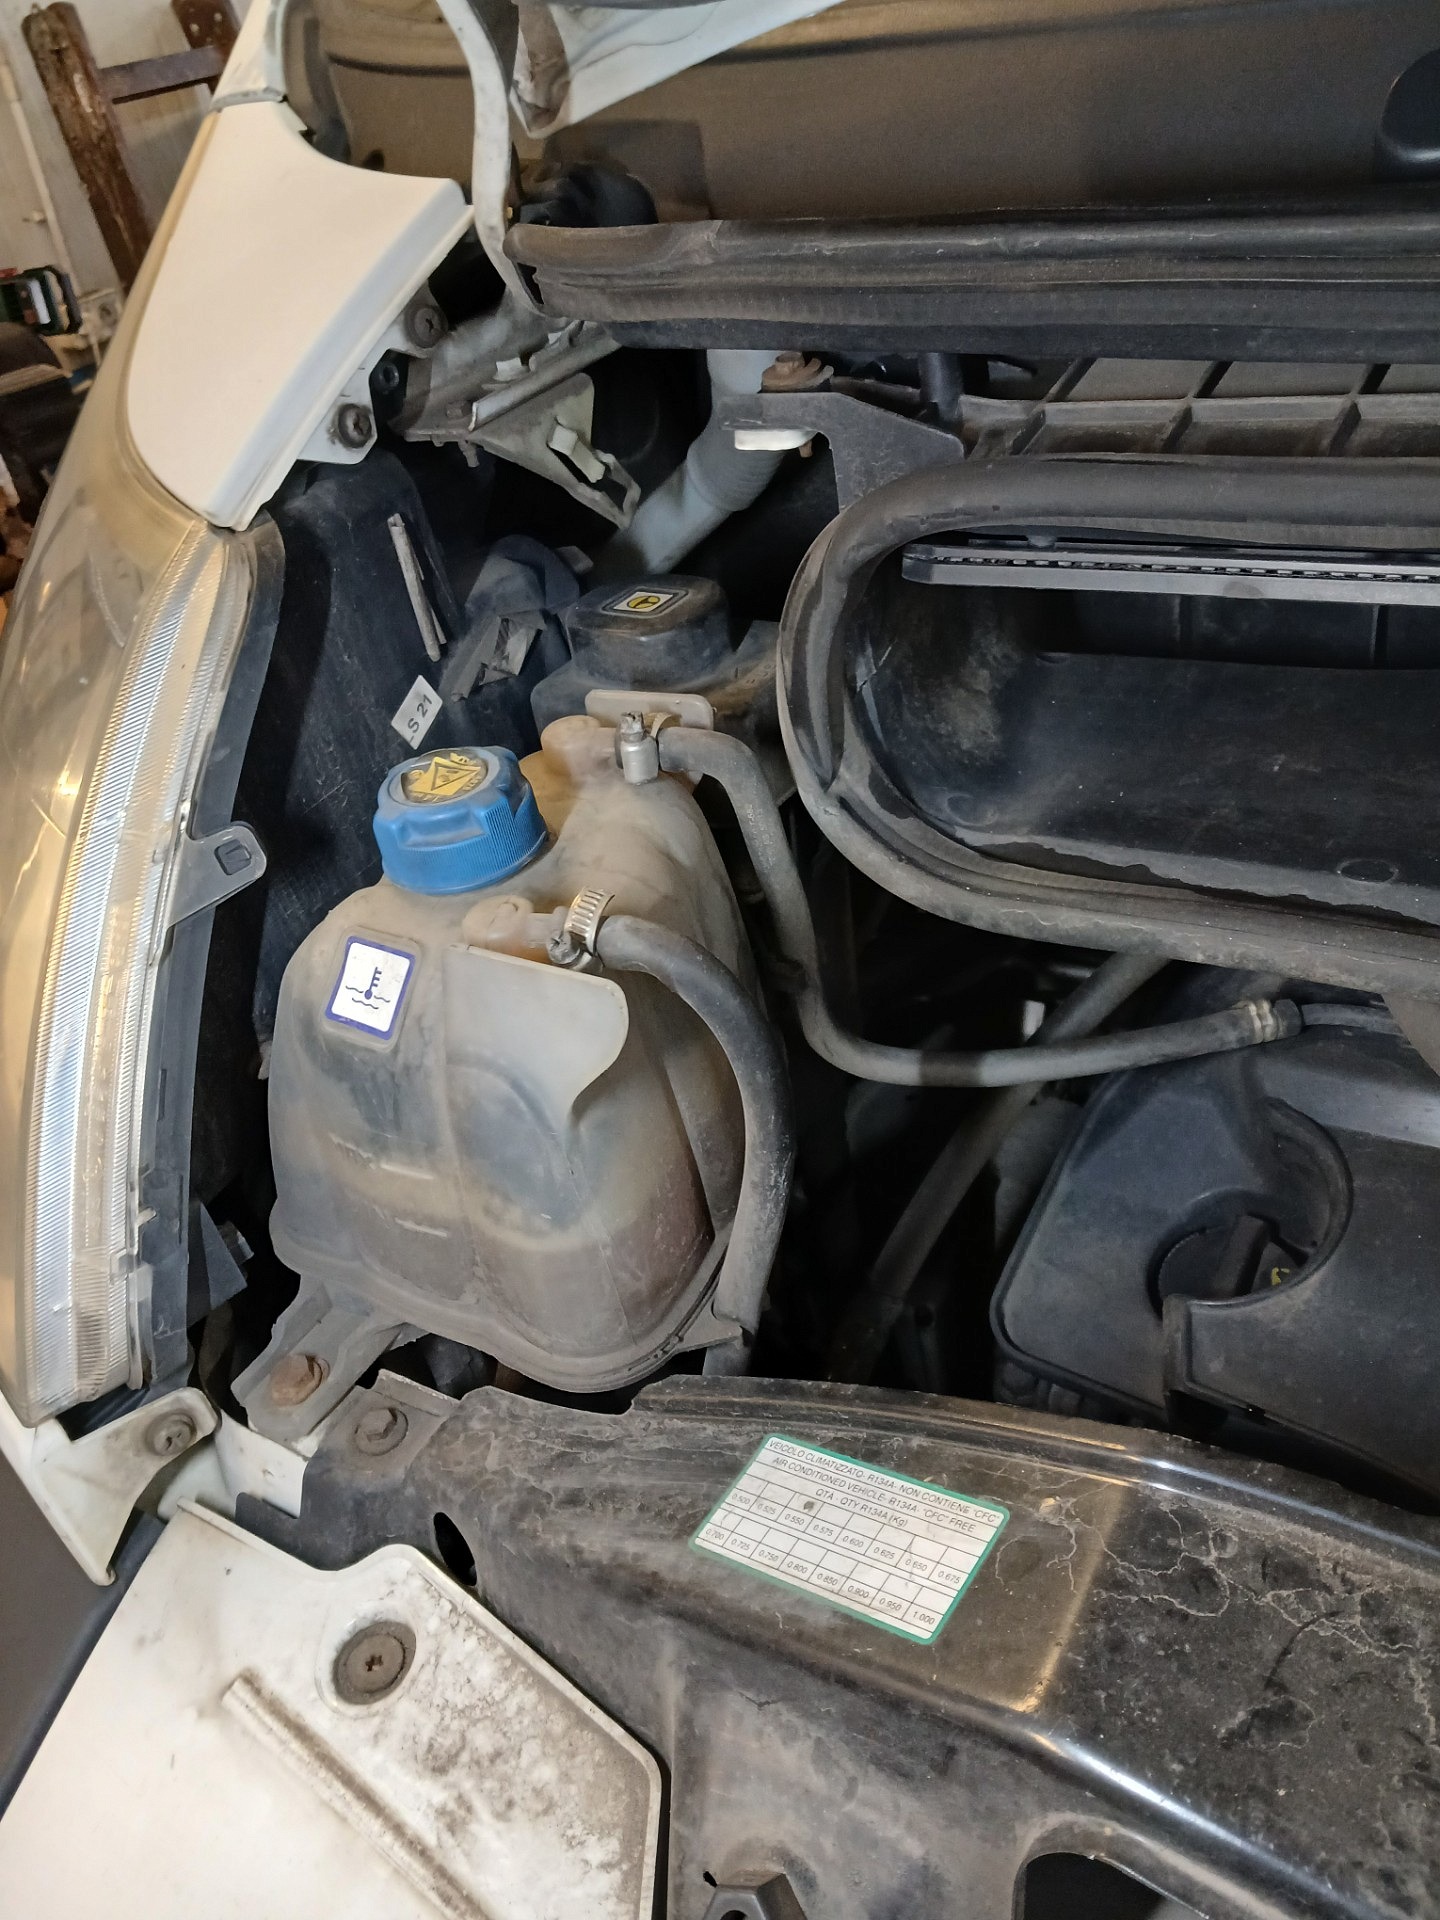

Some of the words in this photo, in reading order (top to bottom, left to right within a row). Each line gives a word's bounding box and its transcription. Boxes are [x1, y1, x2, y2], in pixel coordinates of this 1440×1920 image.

[769, 1440, 806, 1458] VEICOLO
[899, 1485, 920, 1498] NON
[921, 1492, 970, 1514] CONTIENE
[772, 1457, 788, 1468] AIR
[788, 1461, 847, 1488] CONDITIONED
[949, 1517, 976, 1533] FREE
[840, 1497, 860, 1508] QTY
[860, 1504, 888, 1519] R134A
[888, 1513, 908, 1527] (Kg)
